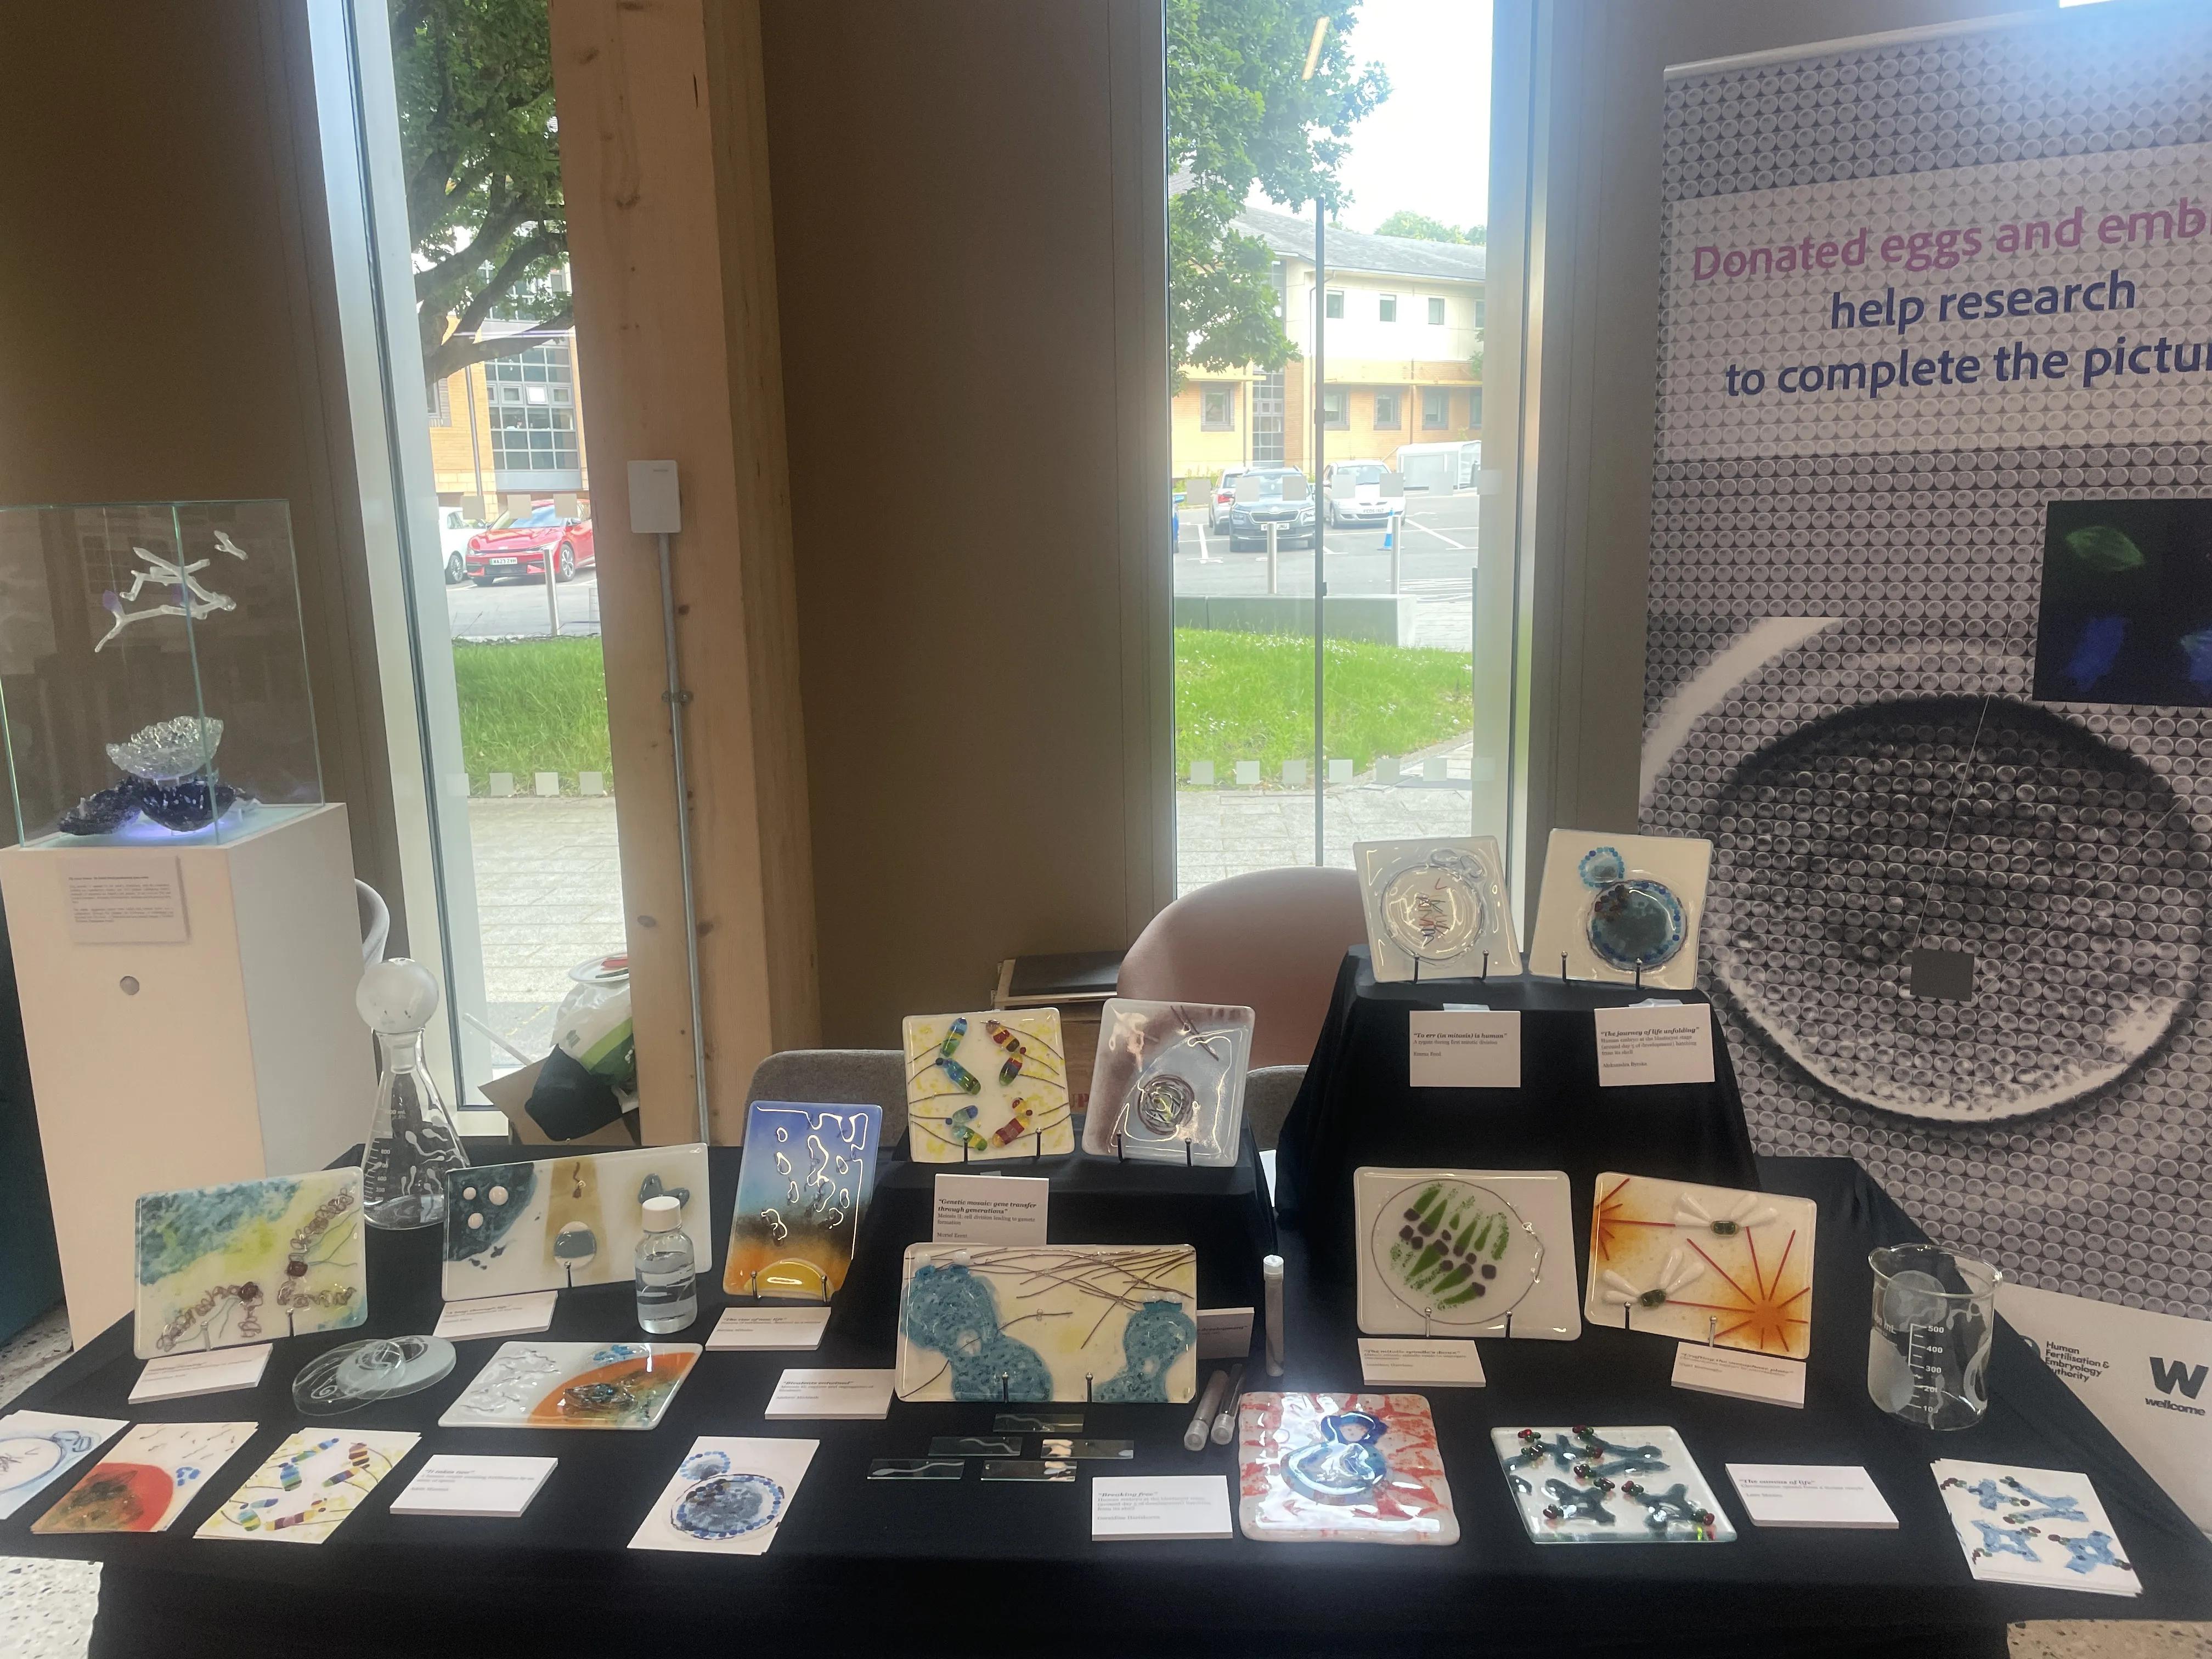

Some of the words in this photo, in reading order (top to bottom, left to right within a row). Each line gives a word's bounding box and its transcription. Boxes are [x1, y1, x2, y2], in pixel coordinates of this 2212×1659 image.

[1694, 228, 1867, 280] Donated
[1880, 225, 1982, 273] eggs
[1996, 207, 2085, 252] and
[1831, 288, 1925, 335] help
[1939, 270, 2136, 322] research
[1726, 364, 1765, 397] to
[1778, 351, 1980, 398] complete
[1993, 341, 2068, 382] the
[2046, 1341, 2080, 1355] Human
[2046, 1349, 2101, 1367] Fertilisation
[2045, 1357, 2102, 1377] Embryology
[2051, 1368, 2090, 1383] uthority
[2149, 1356, 2209, 1400] W
[2145, 1398, 2205, 1415] wellcome
